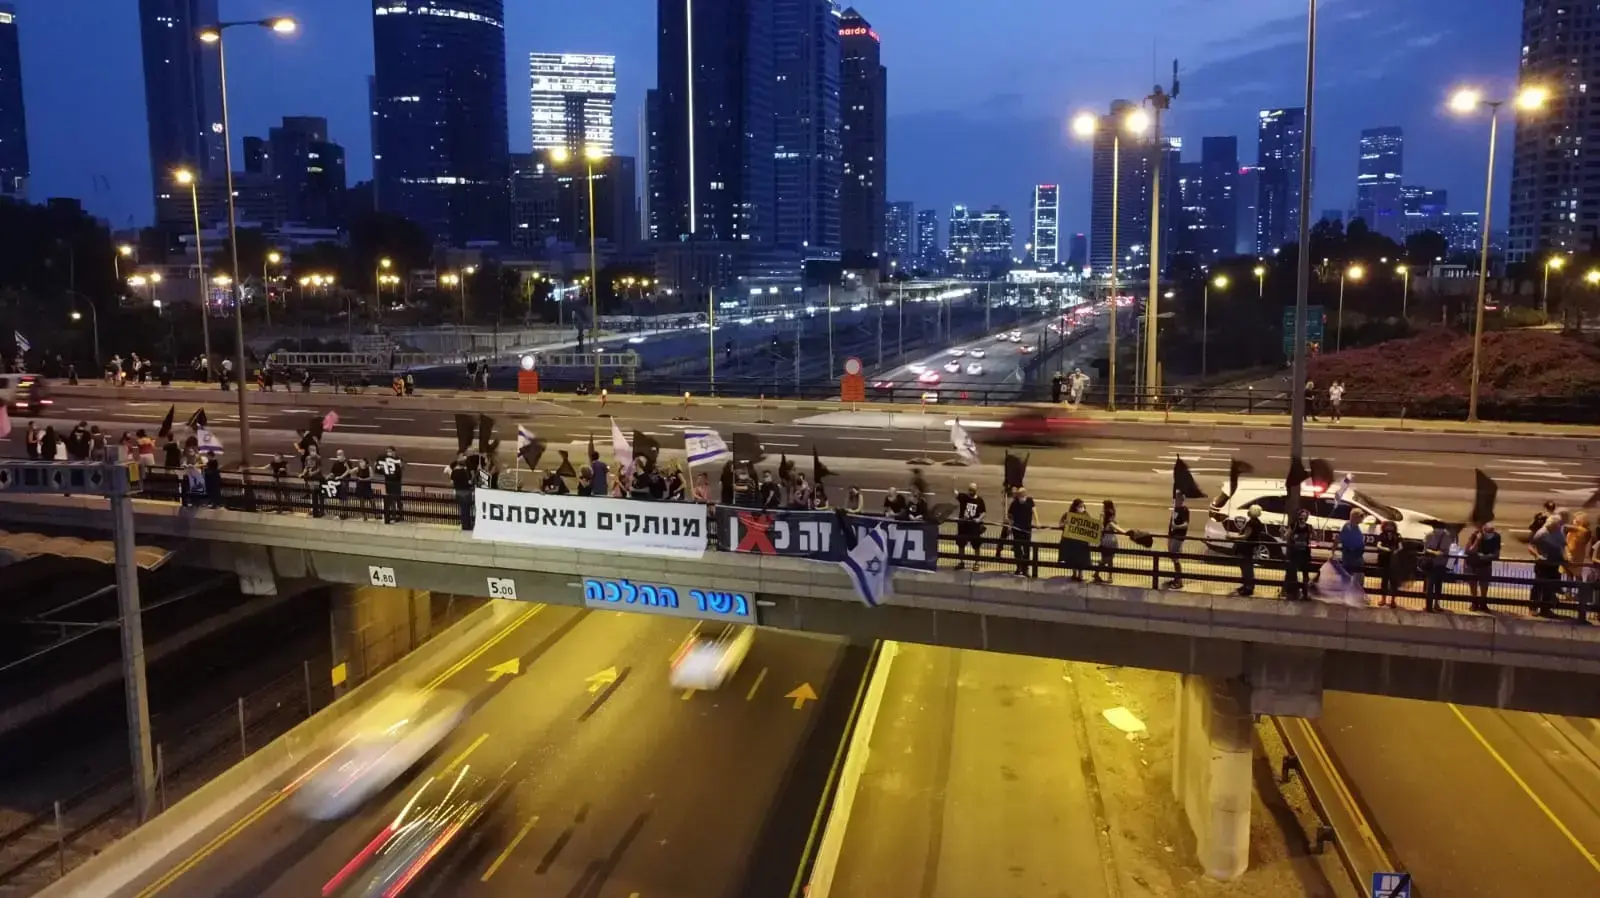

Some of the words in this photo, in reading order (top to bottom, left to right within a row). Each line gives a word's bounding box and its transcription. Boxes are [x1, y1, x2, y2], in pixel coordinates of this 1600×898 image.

[482, 502, 586, 528] נמאסתם!
[597, 512, 700, 538] מנותקים
[800, 521, 832, 552] זה
[372, 570, 394, 584] 4.80
[491, 582, 514, 596] 5.00
[584, 578, 680, 609] ההלכה
[689, 589, 749, 617] גשר
